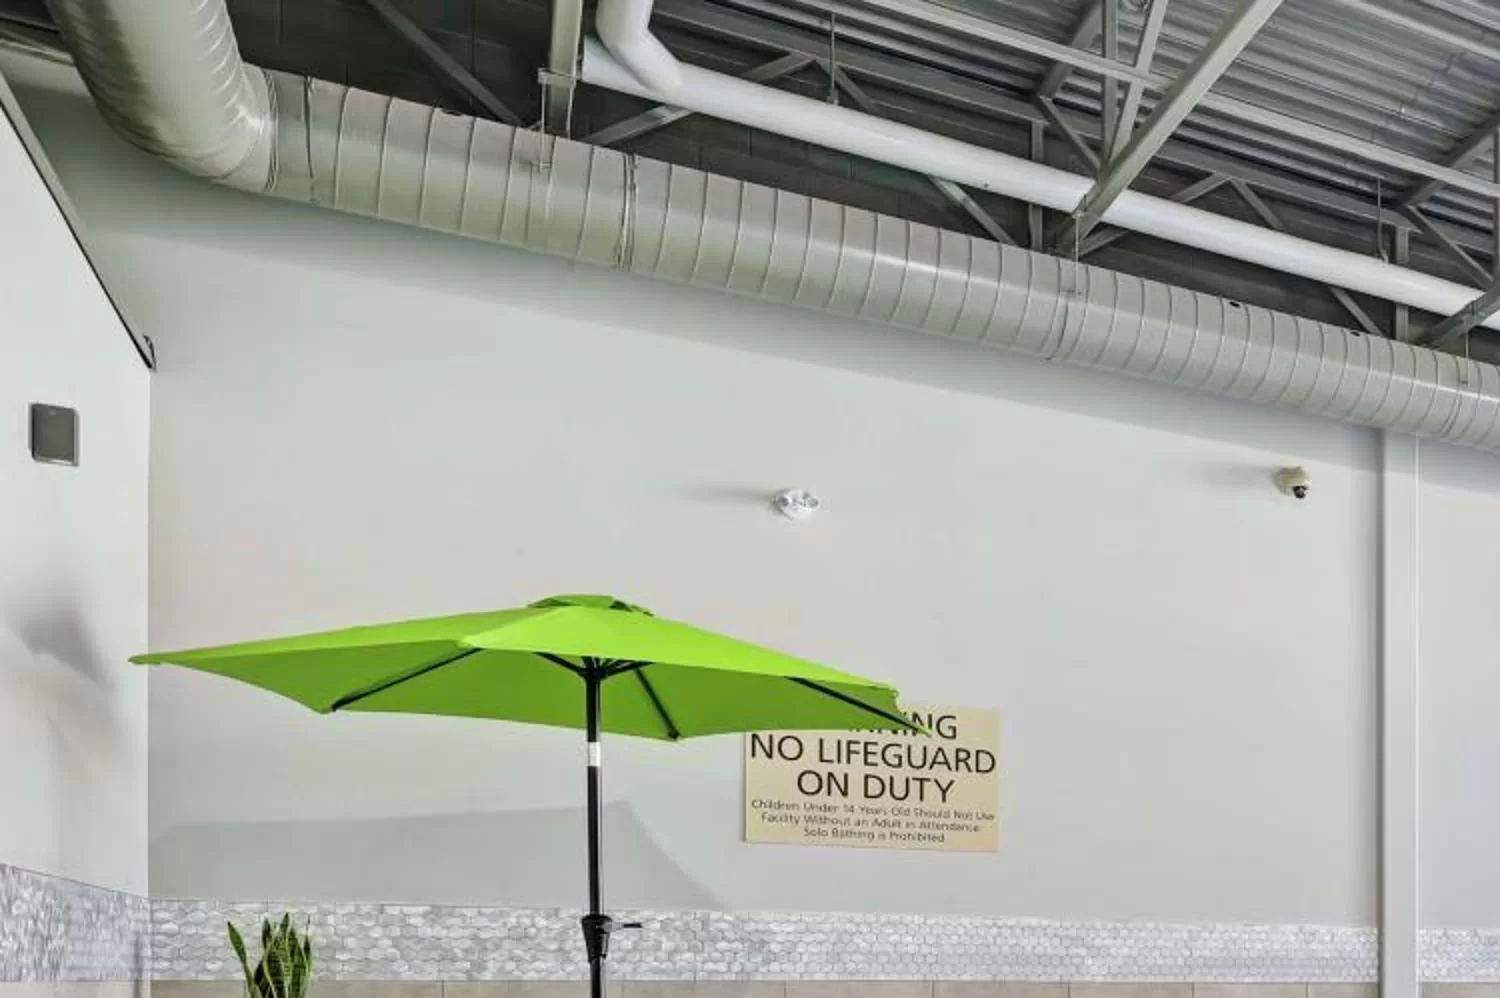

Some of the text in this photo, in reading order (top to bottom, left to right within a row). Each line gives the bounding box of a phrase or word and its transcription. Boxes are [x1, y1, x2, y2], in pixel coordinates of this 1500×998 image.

[750, 733, 996, 774] NO LIFEGUARD
[796, 769, 956, 803] ON DUTY
[751, 799, 800, 811] Children
[803, 801, 839, 813] Under
[858, 804, 888, 816] Years
[890, 806, 911, 817] Old
[913, 807, 951, 819] Should
[953, 810, 973, 820] Not
[975, 811, 995, 821] Use
[761, 811, 800, 825] Facility
[803, 815, 851, 827] Without
[853, 818, 869, 827] an
[871, 818, 902, 829] Adult
[919, 820, 980, 833] Attendance
[803, 827, 829, 837] Solo
[831, 827, 875, 842] Bathing
[889, 831, 945, 843] Prohibited
